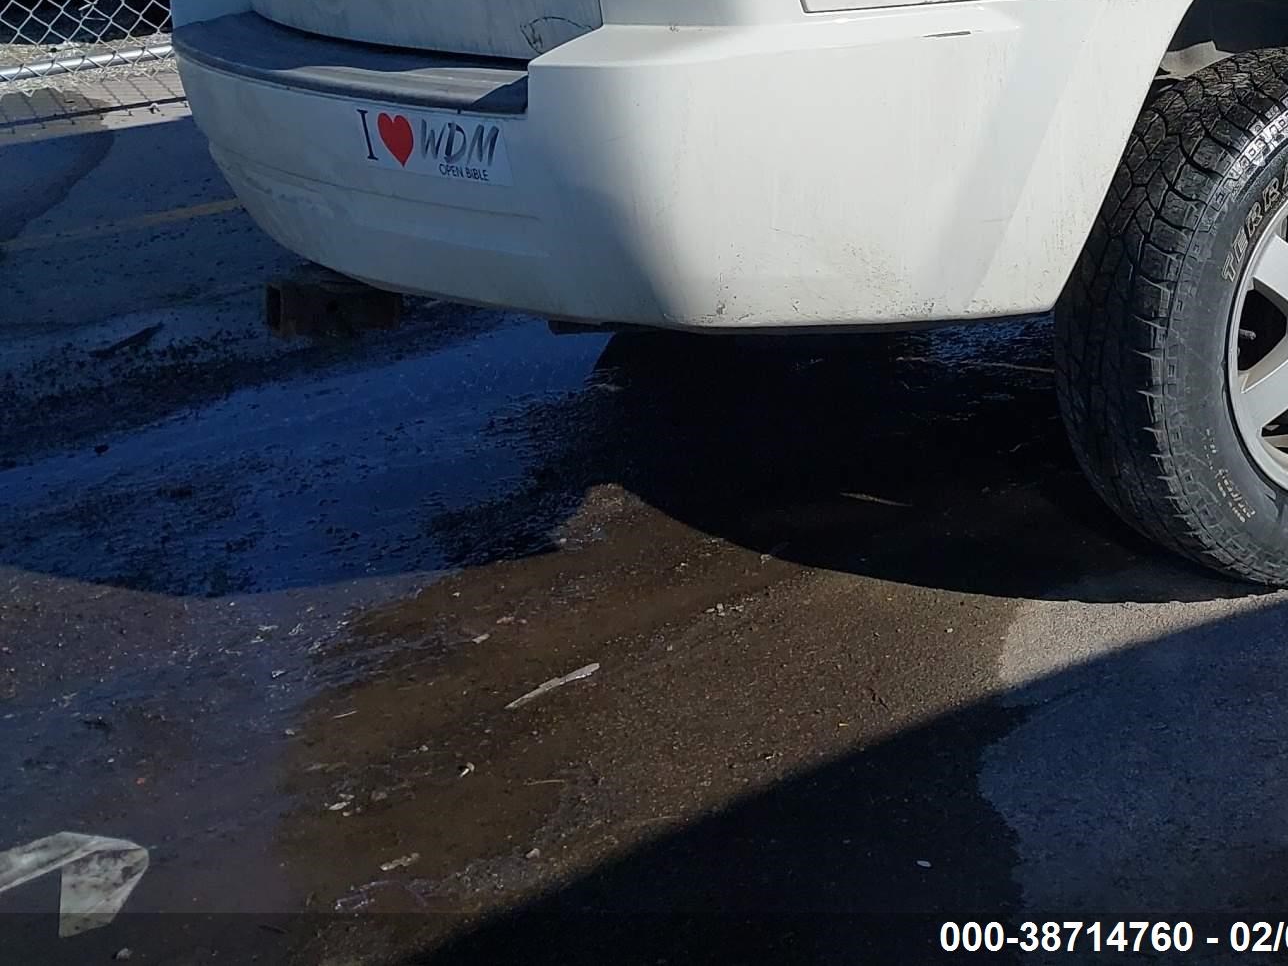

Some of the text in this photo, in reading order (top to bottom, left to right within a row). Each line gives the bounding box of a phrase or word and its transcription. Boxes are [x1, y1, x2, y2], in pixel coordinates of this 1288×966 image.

[356, 108, 379, 161] I
[438, 163, 489, 181] OPEN BIBLE
